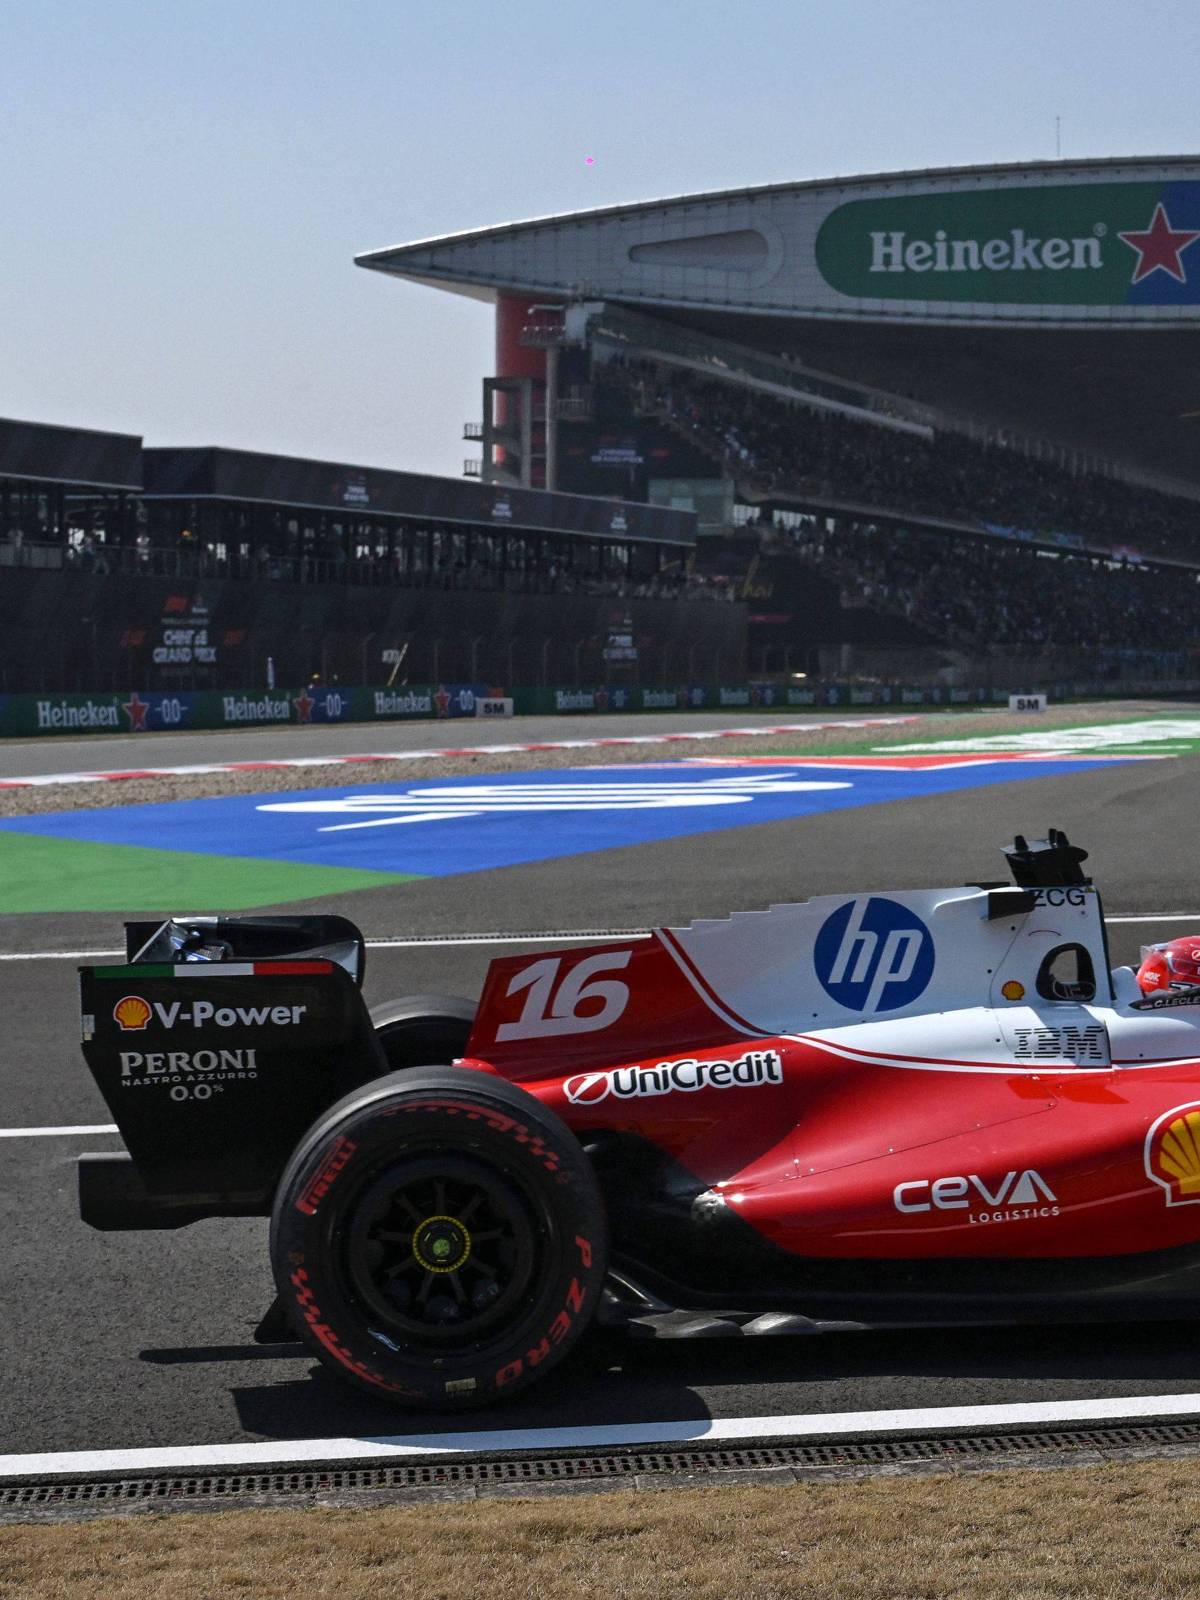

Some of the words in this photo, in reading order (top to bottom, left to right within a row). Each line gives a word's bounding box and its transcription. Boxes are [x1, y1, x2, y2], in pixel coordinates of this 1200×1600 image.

[37, 700, 119, 728] Heineken
[223, 696, 290, 721] Heineken
[1017, 699, 1039, 710] SM
[827, 898, 923, 1012] hp
[495, 950, 633, 1042] 16
[153, 1001, 307, 1029] V-Power
[1014, 1026, 1105, 1059] IBM
[119, 1049, 257, 1076] PERONI
[612, 1053, 780, 1096] UniCredit
[121, 1075, 182, 1087] NASTRO
[187, 1071, 258, 1082] AZZURRO
[295, 1135, 357, 1216] PIRELLI
[969, 1206, 1061, 1224] LOGISTICS
